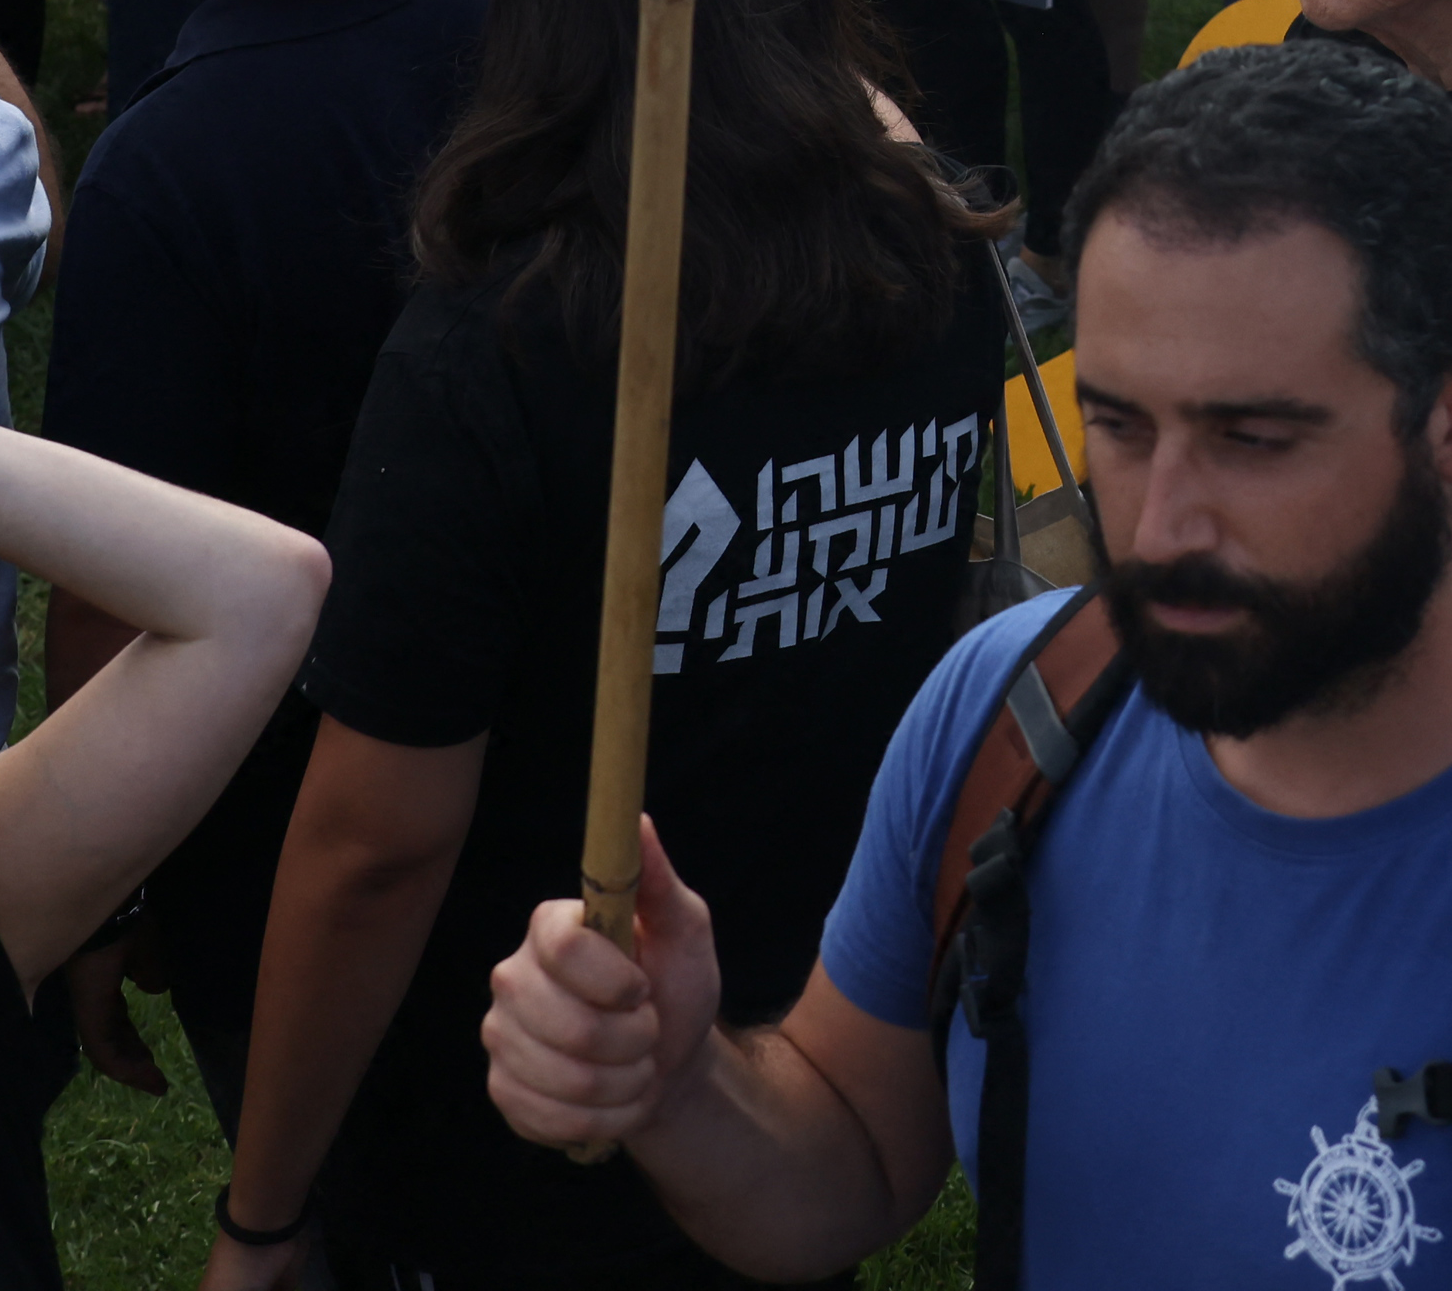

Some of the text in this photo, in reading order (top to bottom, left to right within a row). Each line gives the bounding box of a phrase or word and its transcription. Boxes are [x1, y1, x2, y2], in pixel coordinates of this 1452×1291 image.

[738, 459, 962, 599] שומע
[757, 412, 979, 531] מישהו
[703, 567, 889, 663] אותי
